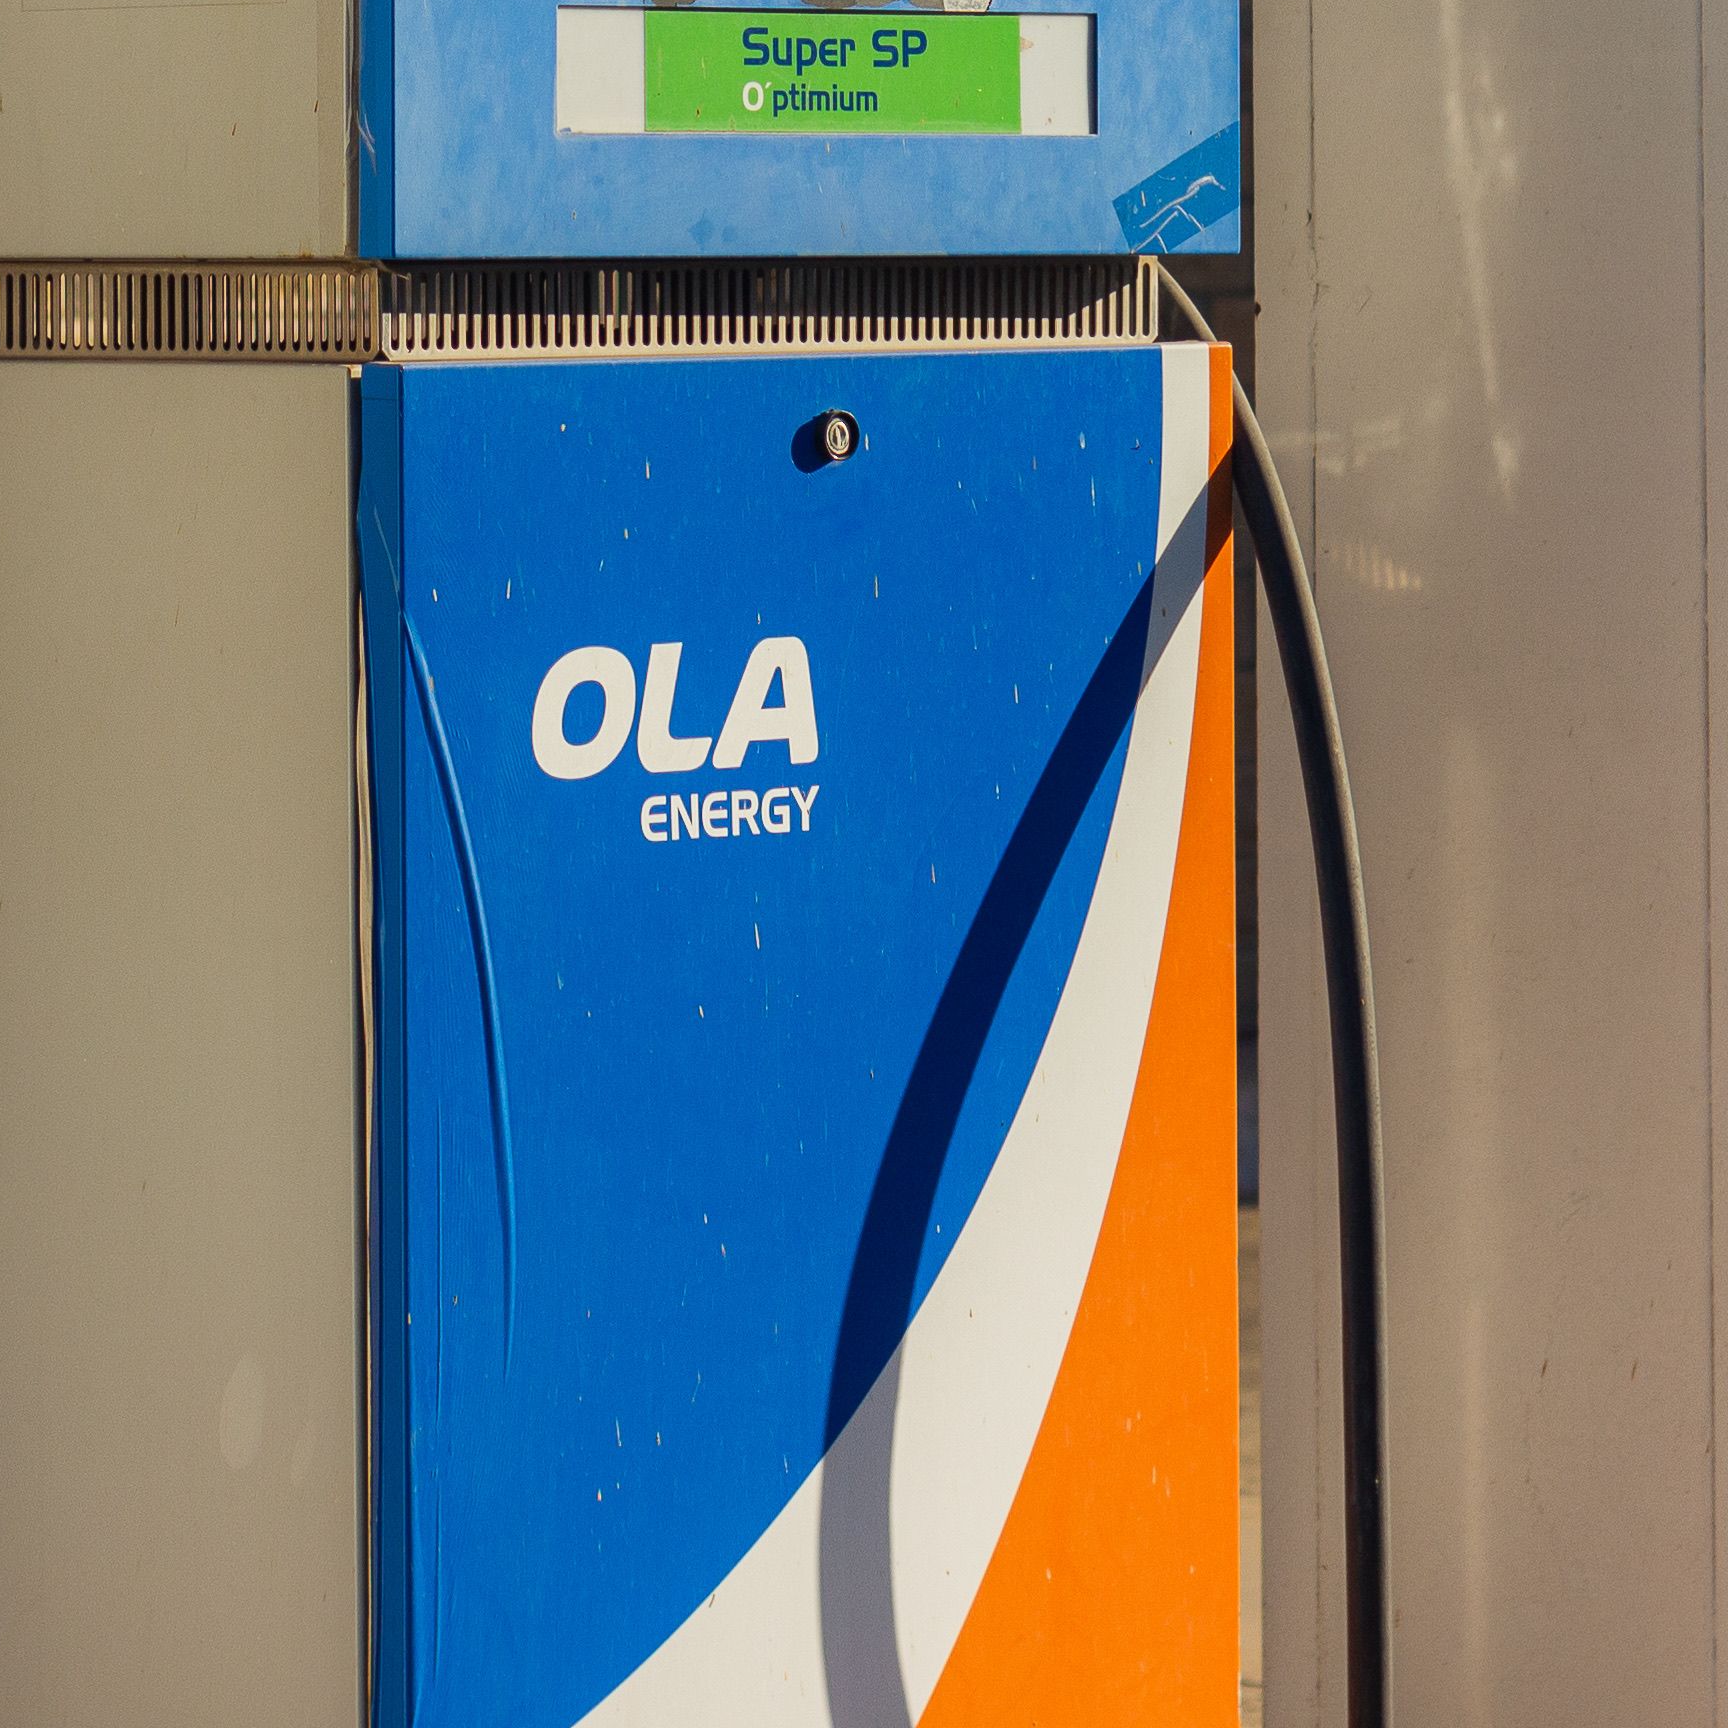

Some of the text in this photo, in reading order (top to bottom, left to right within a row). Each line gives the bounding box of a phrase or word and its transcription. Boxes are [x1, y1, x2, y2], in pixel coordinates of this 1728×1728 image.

[742, 26, 928, 76] Super SP
[531, 635, 820, 780] OLA
[640, 784, 821, 843] ENERGY
